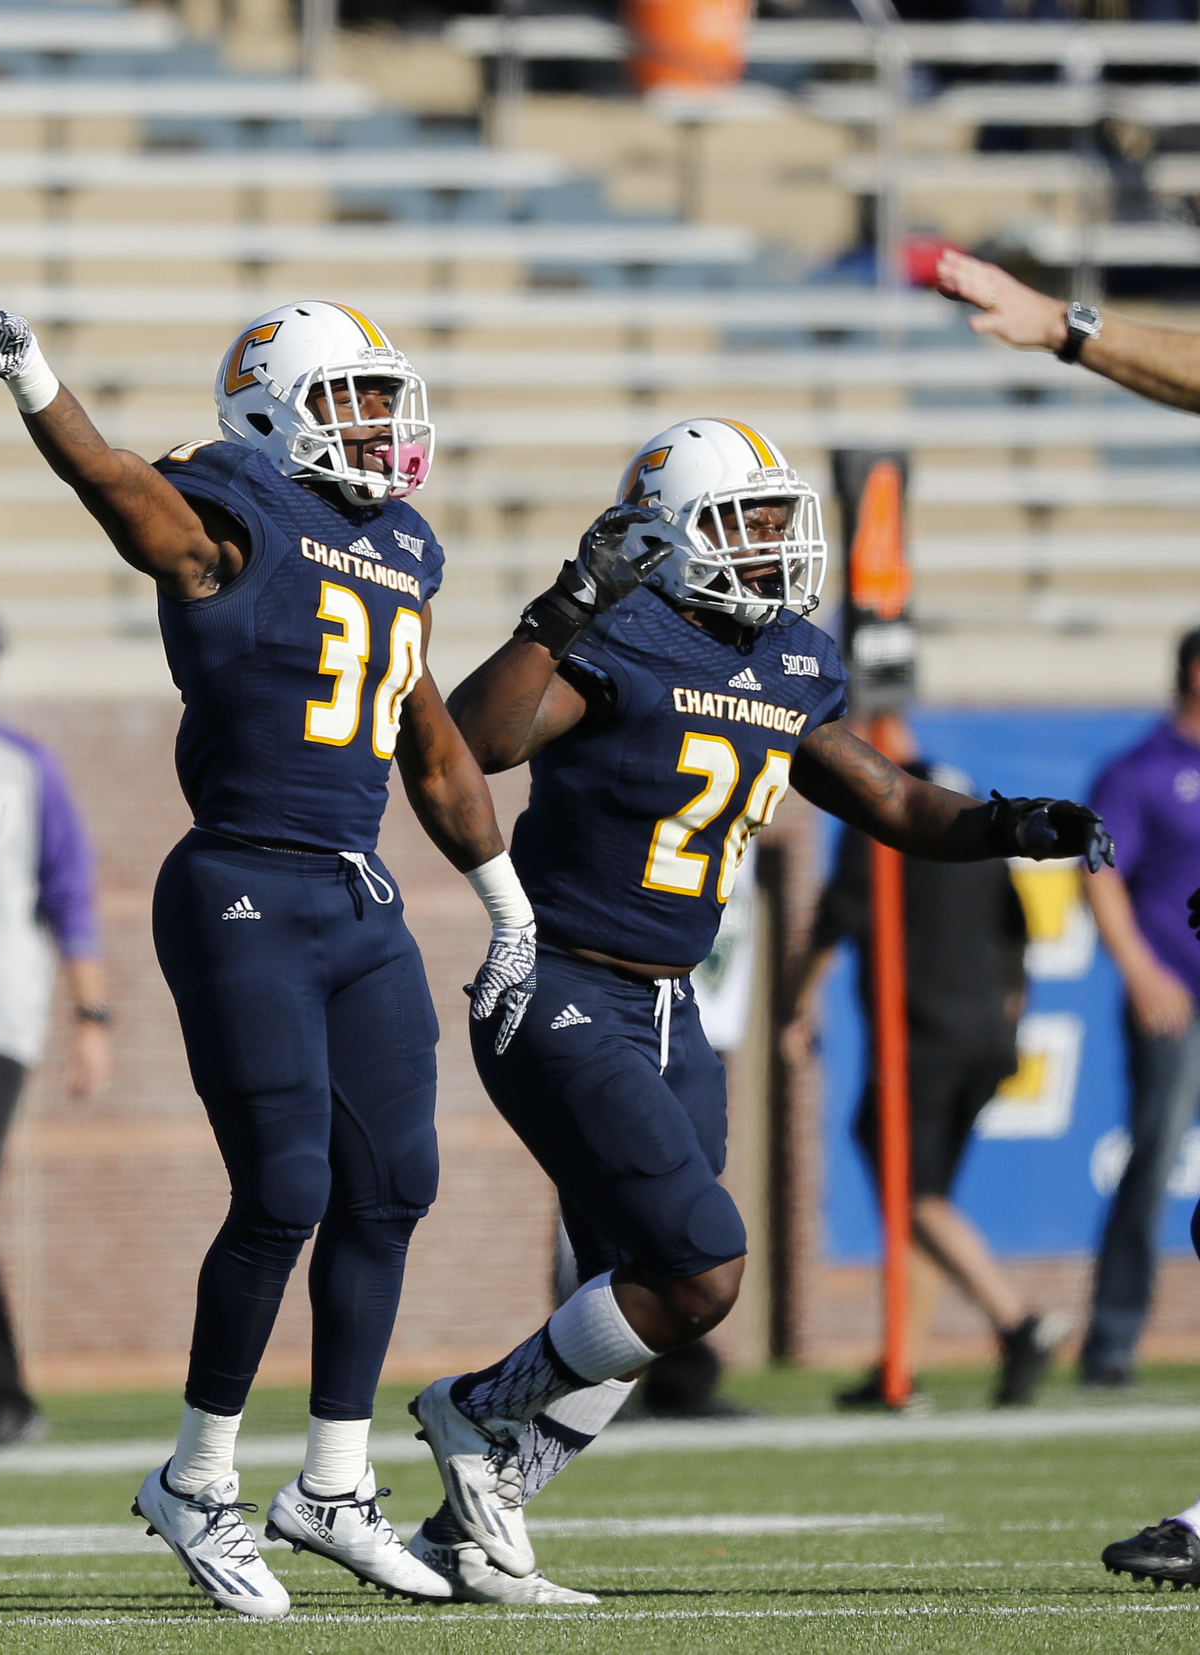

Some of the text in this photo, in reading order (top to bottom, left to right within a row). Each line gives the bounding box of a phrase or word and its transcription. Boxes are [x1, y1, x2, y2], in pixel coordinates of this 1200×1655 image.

[223, 321, 284, 397] C
[300, 536, 421, 602] CHATTANOOGA
[304, 580, 422, 760] 30
[781, 653, 820, 678] SOCON
[672, 687, 809, 736] CHATTANOOGA
[295, 1503, 335, 1545] adidas
